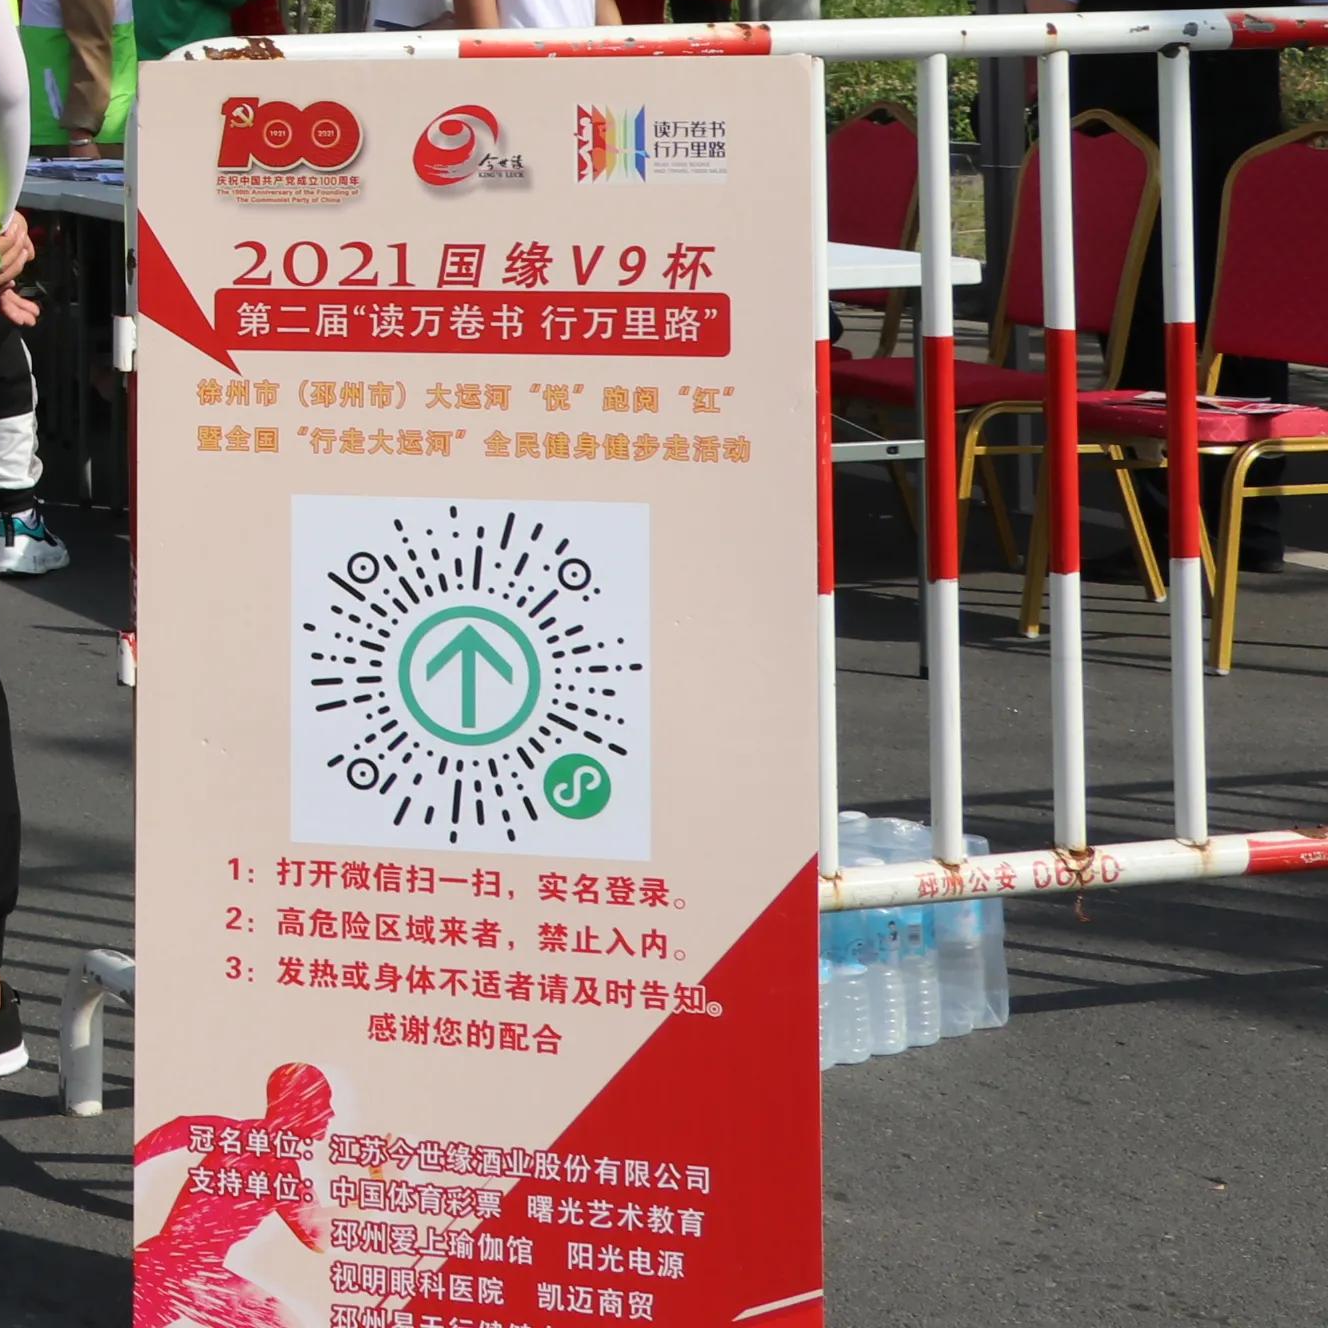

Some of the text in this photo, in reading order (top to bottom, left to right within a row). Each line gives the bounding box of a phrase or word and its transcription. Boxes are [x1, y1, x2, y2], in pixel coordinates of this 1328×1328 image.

[653, 120, 727, 138] 读万卷书
[653, 140, 727, 159] 行万里路
[216, 174, 360, 187] 庆祝中国共产党成立100周年
[231, 240, 716, 291] 2021国缘V9杯
[236, 301, 719, 343] 第二届“读万卷书 行万里路”
[367, 1012, 563, 1056] 感谢您的配合
[188, 1124, 711, 1195] 冠名单位： 江苏今世缘酒业股份有限公司
[188, 1166, 705, 1238] 支持单位： 中国体育彩票 曙光艺术教育
[331, 1219, 686, 1281] 邳州爱上瑜伽馆 阳光电源
[330, 1262, 505, 1306] 视明眼科医院
[537, 1281, 655, 1322] 凯迈商贸
